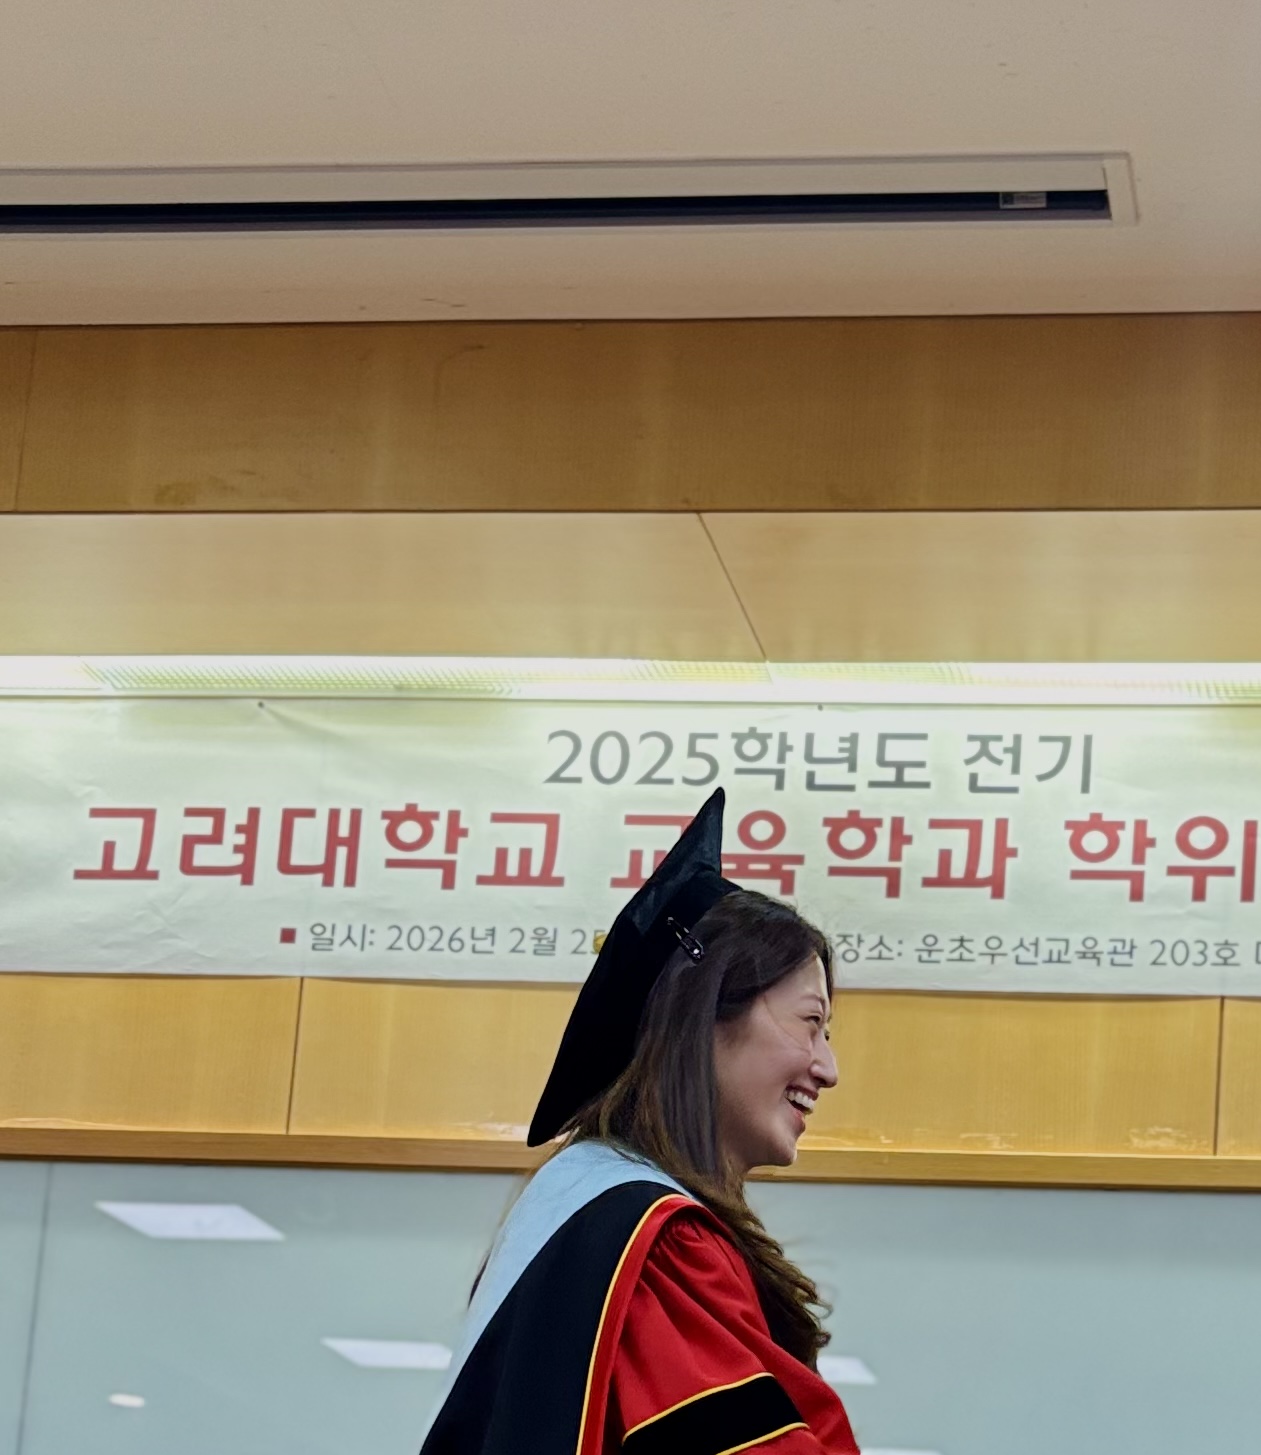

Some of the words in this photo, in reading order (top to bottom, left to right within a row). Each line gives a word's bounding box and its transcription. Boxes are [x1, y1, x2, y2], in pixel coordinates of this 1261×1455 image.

[544, 726, 932, 792] 2025학년도
[963, 733, 1094, 795] 전기
[73, 804, 565, 890] 고려대학교
[610, 809, 1018, 899] 교육학과
[309, 922, 375, 952] 일시:
[386, 924, 497, 955] 2026년
[509, 926, 558, 957] 2월
[835, 933, 904, 963] 장소:
[914, 933, 1138, 967] 운초우선교육관
[1149, 938, 1241, 967] 203호
